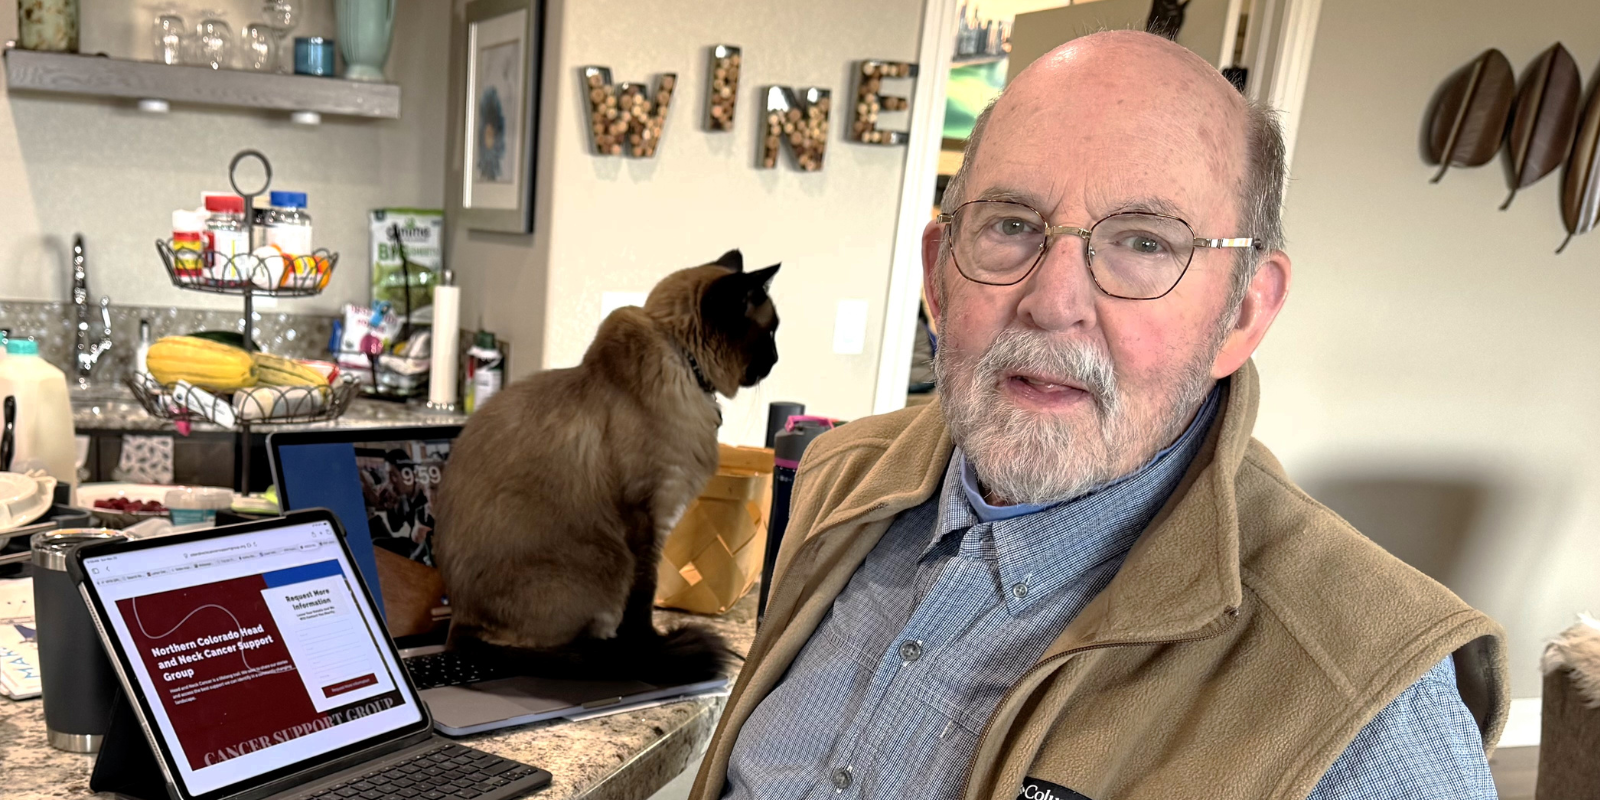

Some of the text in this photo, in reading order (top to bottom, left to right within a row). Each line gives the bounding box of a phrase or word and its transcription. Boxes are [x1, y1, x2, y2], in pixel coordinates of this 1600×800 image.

[580, 43, 919, 172] WINE
[401, 465, 441, 486] 9:59
[285, 588, 330, 603] Request More
[292, 597, 331, 611] Information
[151, 623, 265, 658] Northern Colorado Head
[158, 634, 274, 670] and Neck Cancer Support
[163, 668, 195, 682] Group
[209, 682, 224, 690] support
[203, 696, 394, 767] CANCER SUPPORT GROUP
